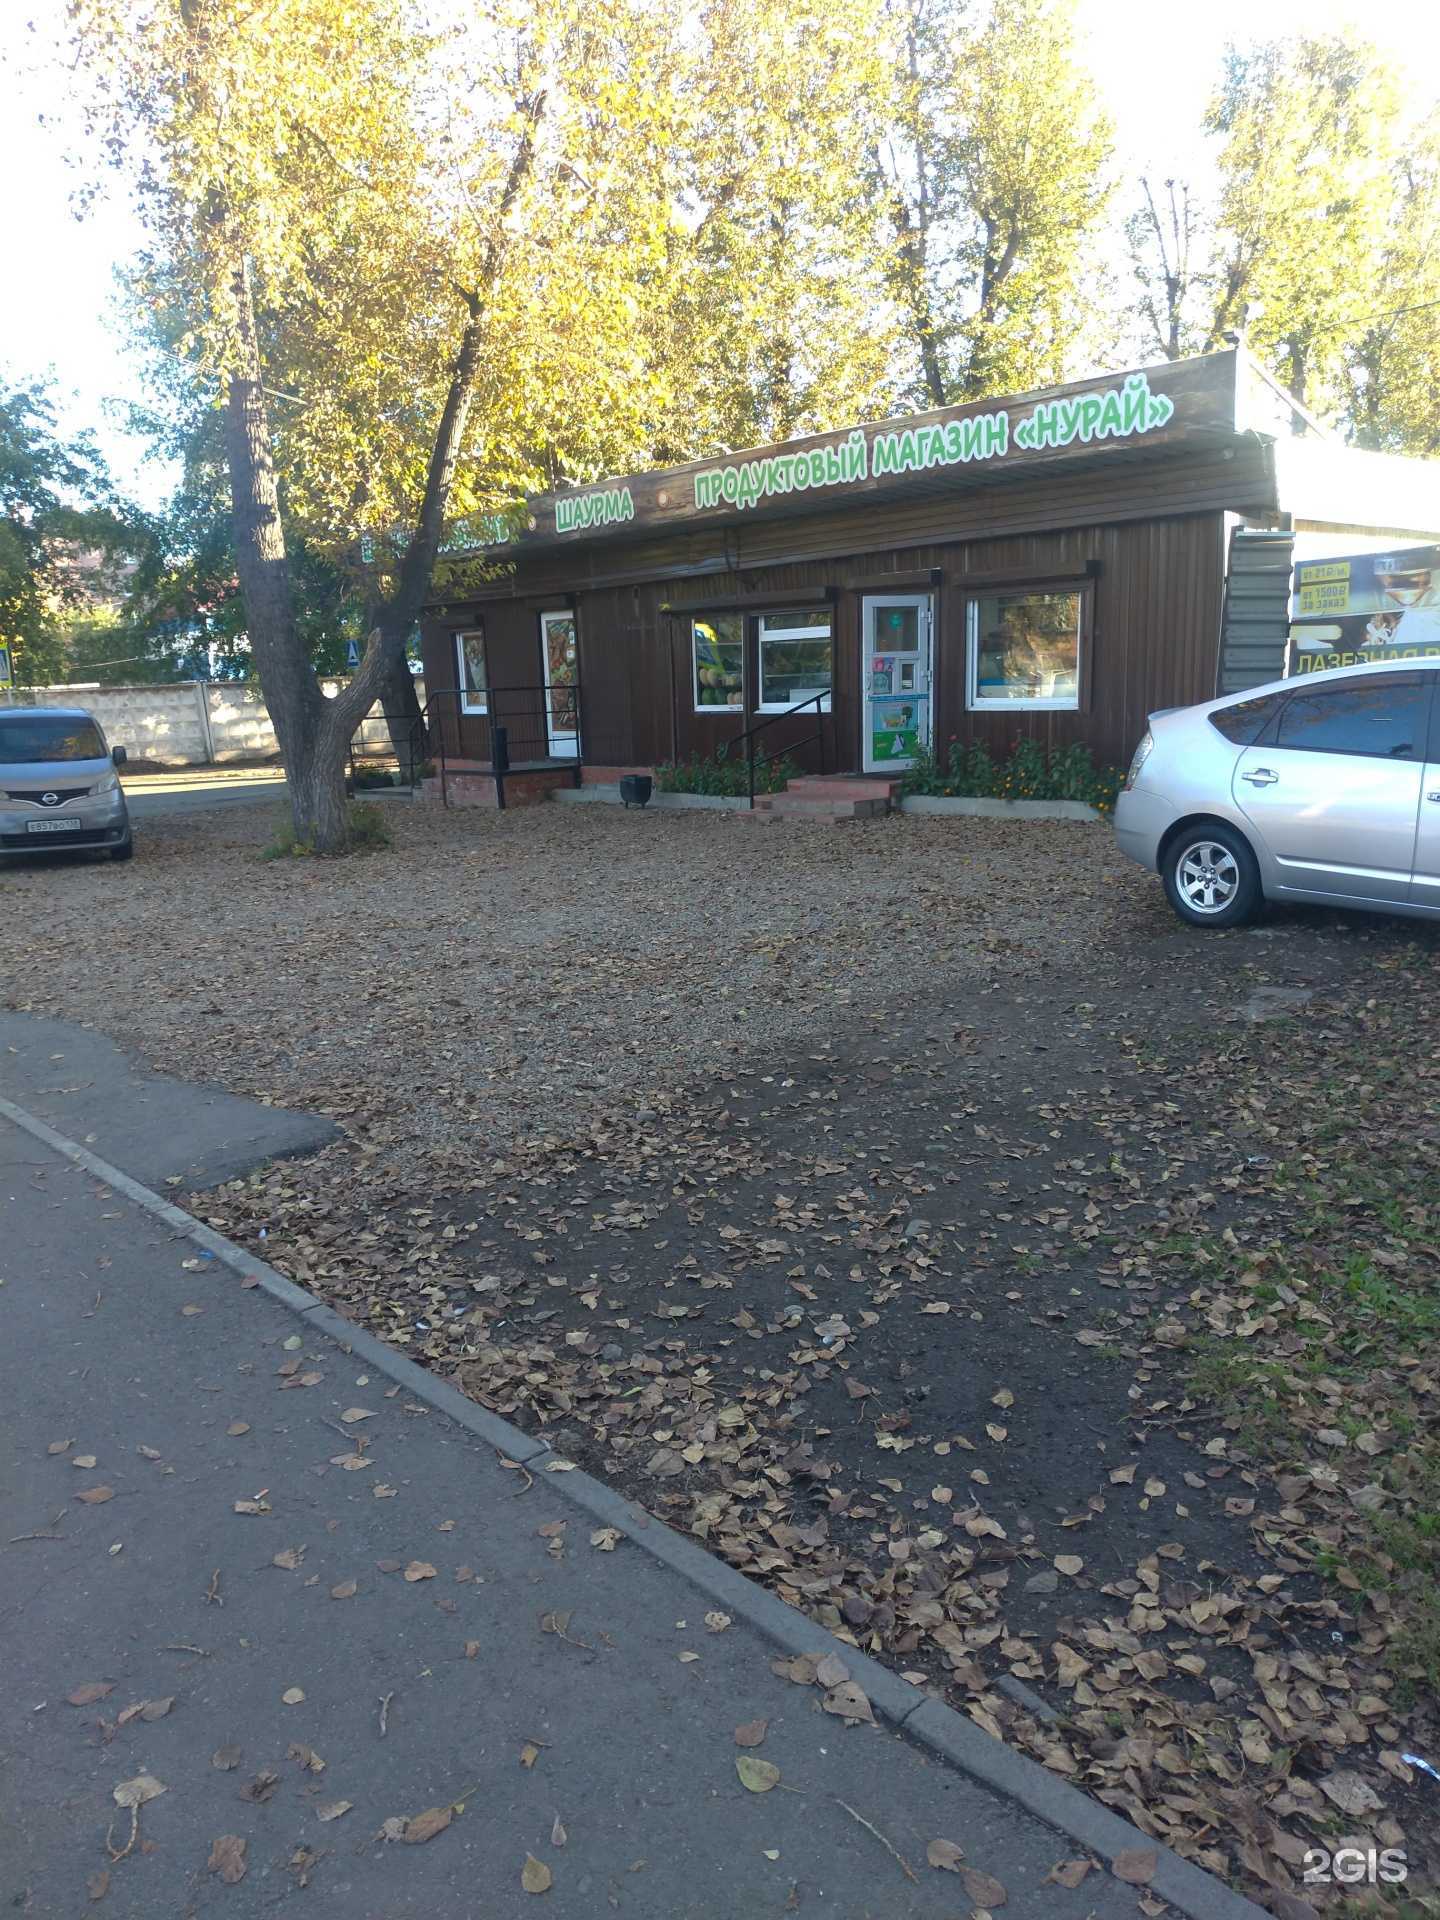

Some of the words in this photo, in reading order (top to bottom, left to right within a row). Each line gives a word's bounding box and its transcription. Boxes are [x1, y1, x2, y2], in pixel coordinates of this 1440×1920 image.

[695, 430, 867, 509] ПРОДУКТОВЫЙ
[872, 410, 1008, 477] МАГАЗИН
[1014, 373, 1174, 450] «НУРАЙ»
[556, 487, 634, 533] ШАУРМА
